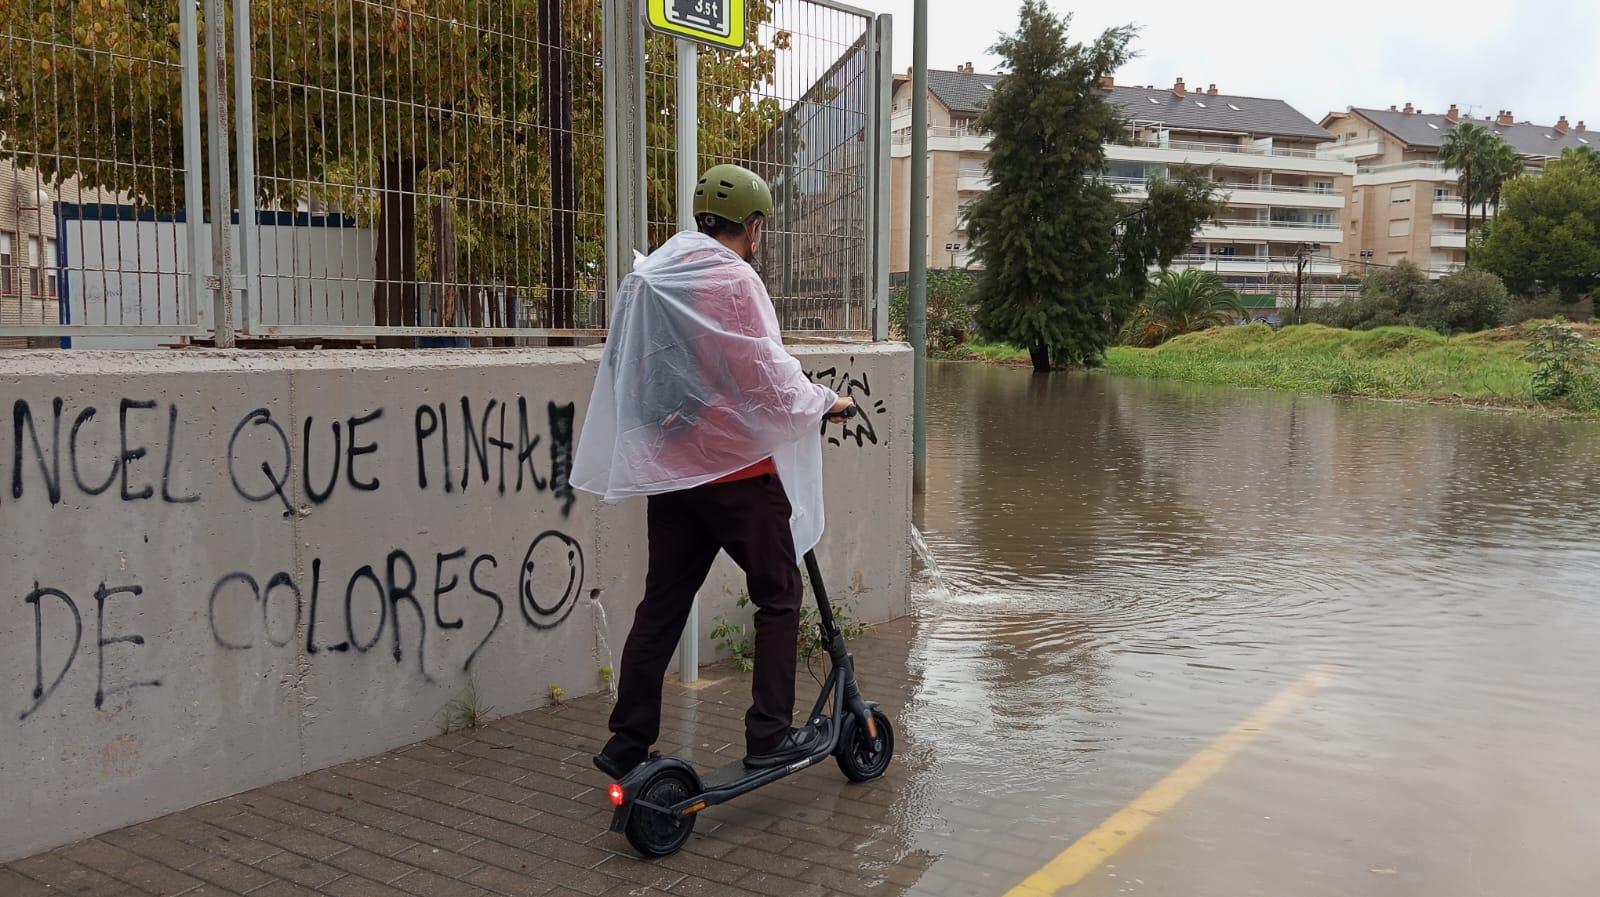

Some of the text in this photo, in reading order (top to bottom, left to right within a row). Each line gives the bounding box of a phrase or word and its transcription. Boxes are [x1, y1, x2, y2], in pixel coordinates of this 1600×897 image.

[227, 407, 385, 517] QUE
[18, 547, 504, 721] DE COLORES
